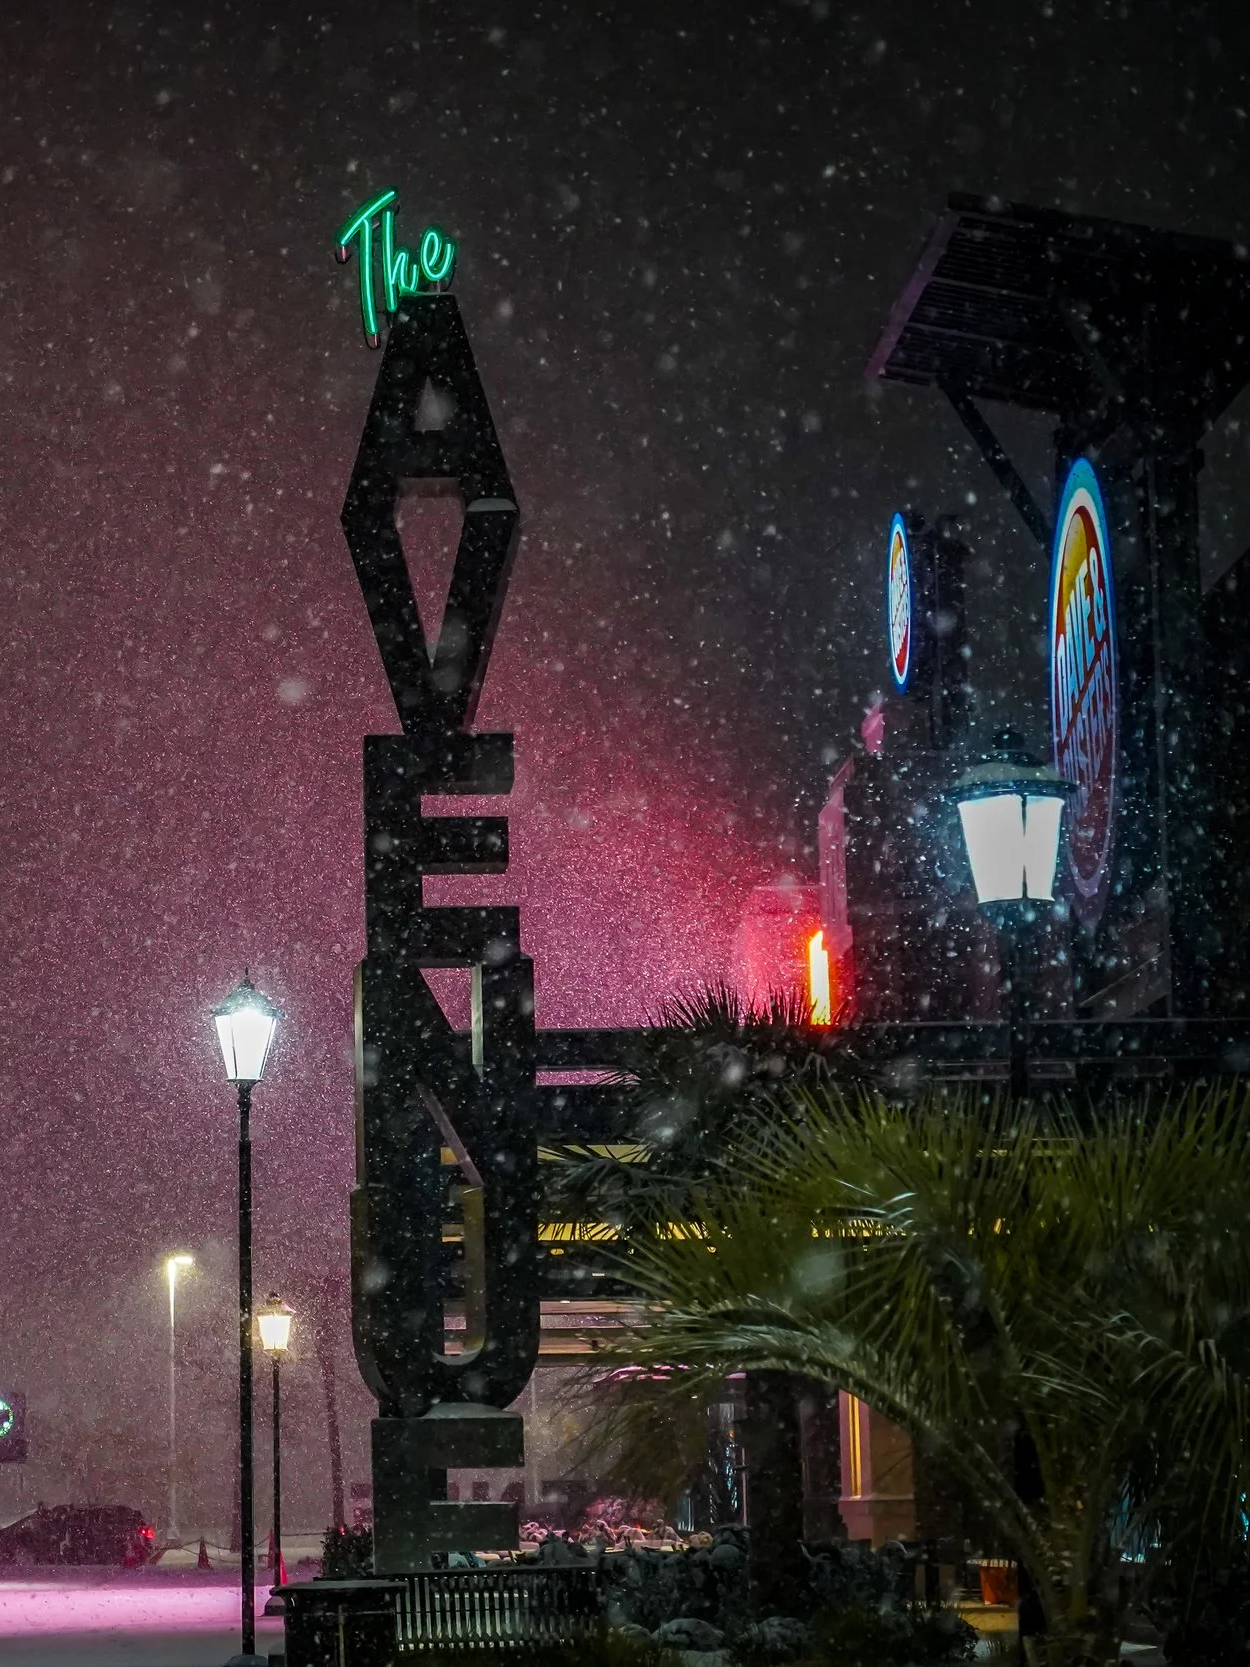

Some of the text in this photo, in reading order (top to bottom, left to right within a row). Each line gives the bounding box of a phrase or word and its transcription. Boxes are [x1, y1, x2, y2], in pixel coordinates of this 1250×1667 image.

[335, 186, 456, 335] The
[1057, 547, 1107, 743] DAVE &
[340, 293, 540, 1570] AVENUE
